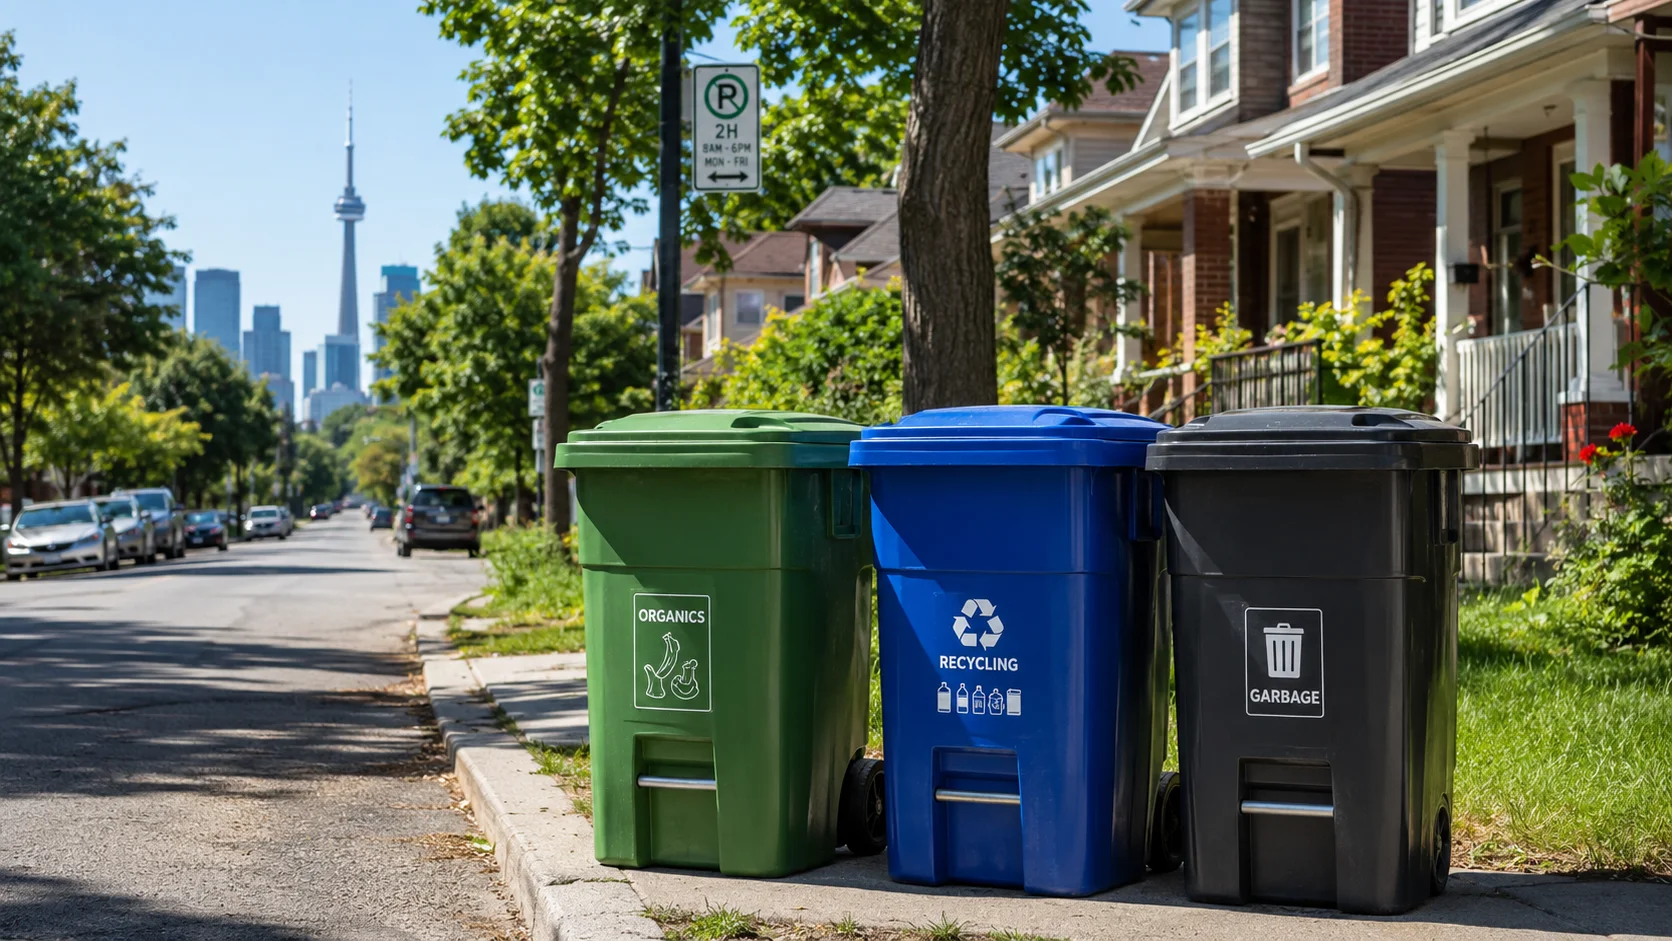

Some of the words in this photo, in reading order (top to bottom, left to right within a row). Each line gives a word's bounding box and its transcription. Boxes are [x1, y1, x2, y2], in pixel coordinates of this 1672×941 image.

[715, 123, 738, 139] 2H
[702, 143, 722, 153] 8AM
[731, 143, 751, 153] 6PM
[704, 157, 725, 167] MON
[734, 156, 749, 167] FRI
[638, 608, 705, 624] ORGANICS
[939, 655, 1019, 672] RECYCLING
[1249, 688, 1320, 705] GARBAGE
